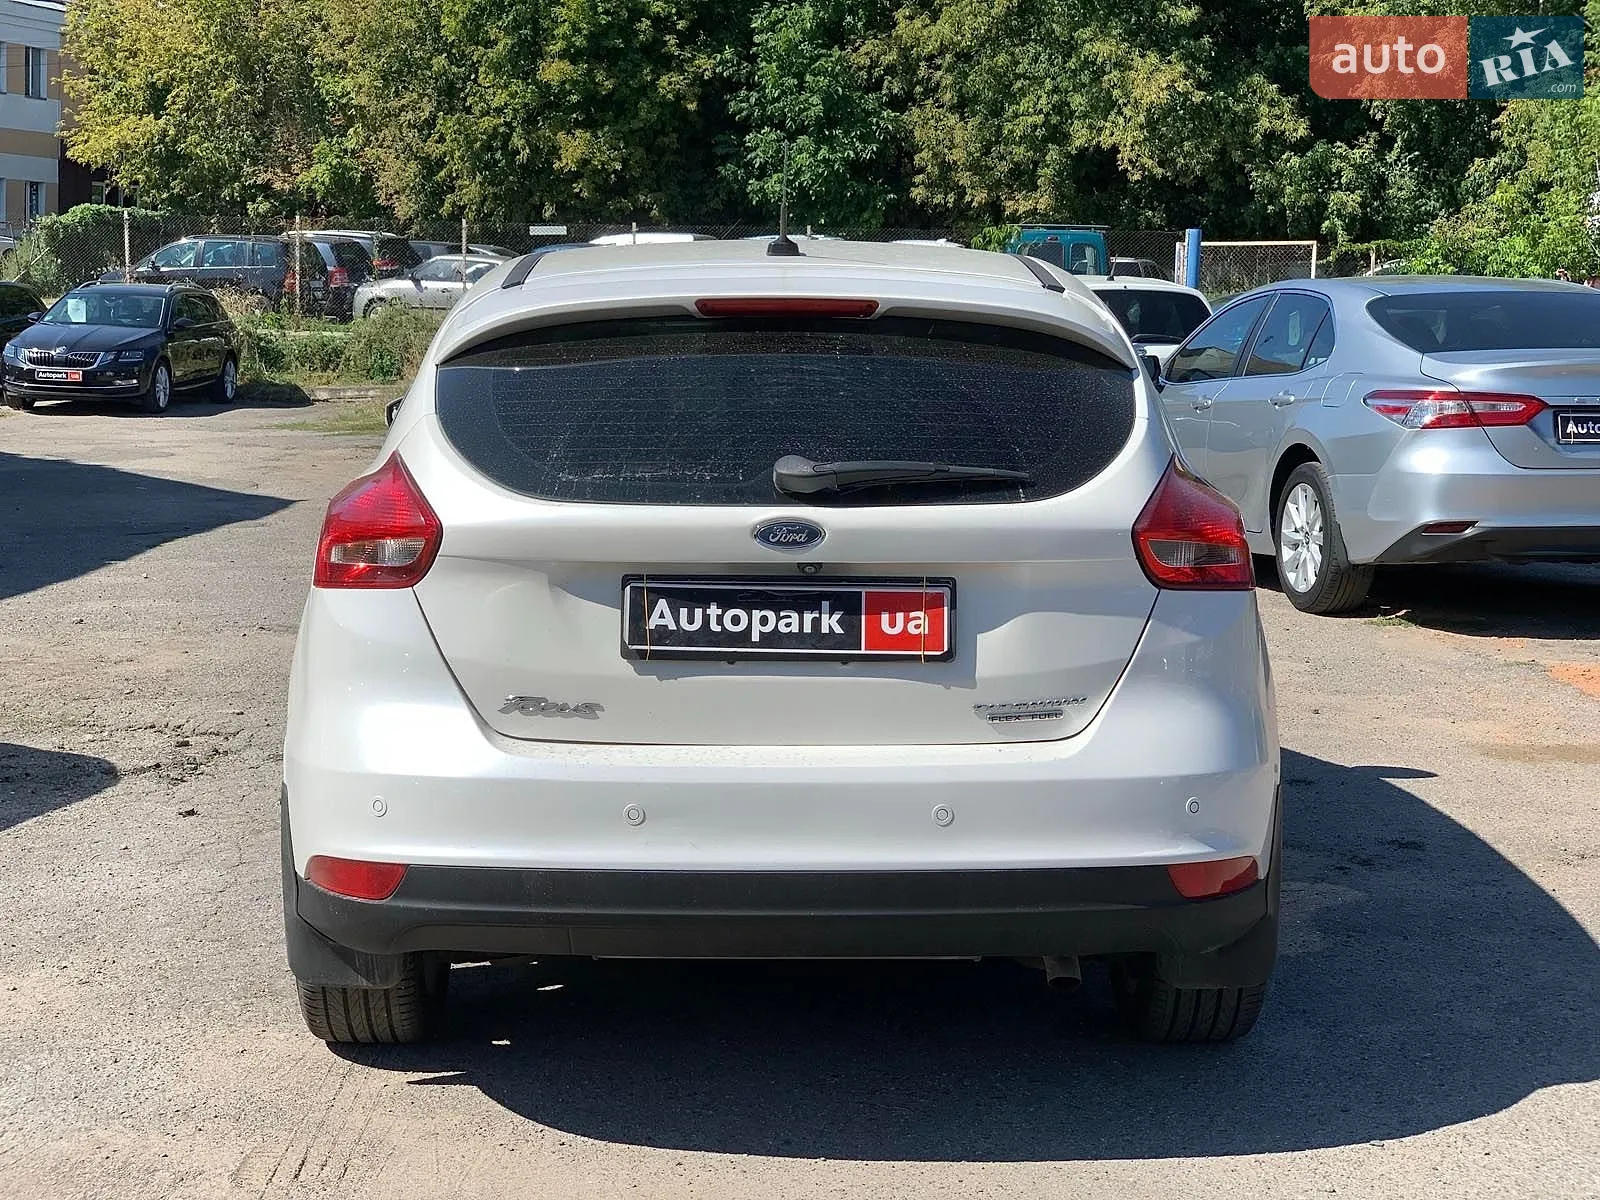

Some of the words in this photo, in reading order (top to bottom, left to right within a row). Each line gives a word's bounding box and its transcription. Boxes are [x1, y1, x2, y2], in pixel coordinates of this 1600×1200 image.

[768, 526, 809, 543] Ford
[648, 598, 845, 642] Autopark
[880, 610, 930, 636] ua
